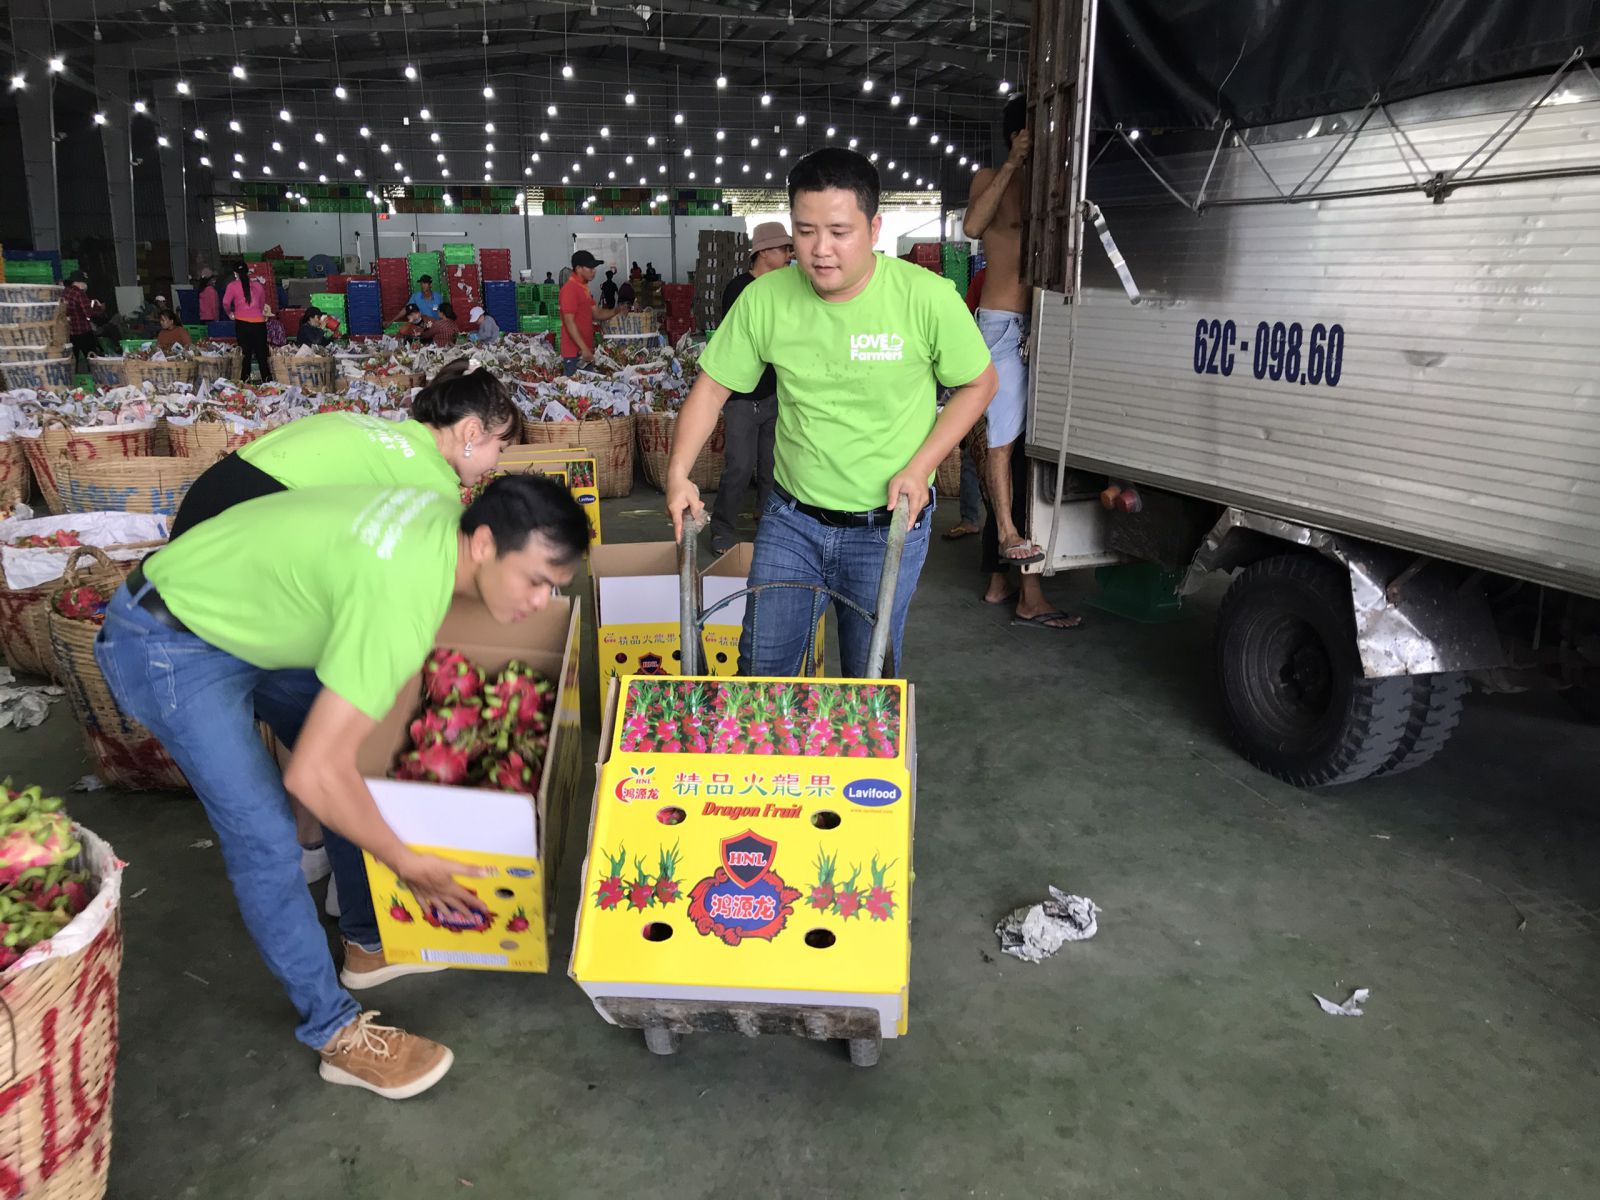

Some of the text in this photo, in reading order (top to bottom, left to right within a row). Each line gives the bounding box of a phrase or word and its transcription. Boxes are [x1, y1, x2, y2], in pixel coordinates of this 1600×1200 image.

[850, 333, 888, 349] LOVE
[672, 772, 836, 797] 精品火龍果
[848, 787, 897, 799] Lavifood
[701, 801, 803, 820] Dragon Fruit
[728, 851, 767, 867] HNL
[710, 893, 776, 920] 鸿源龙
